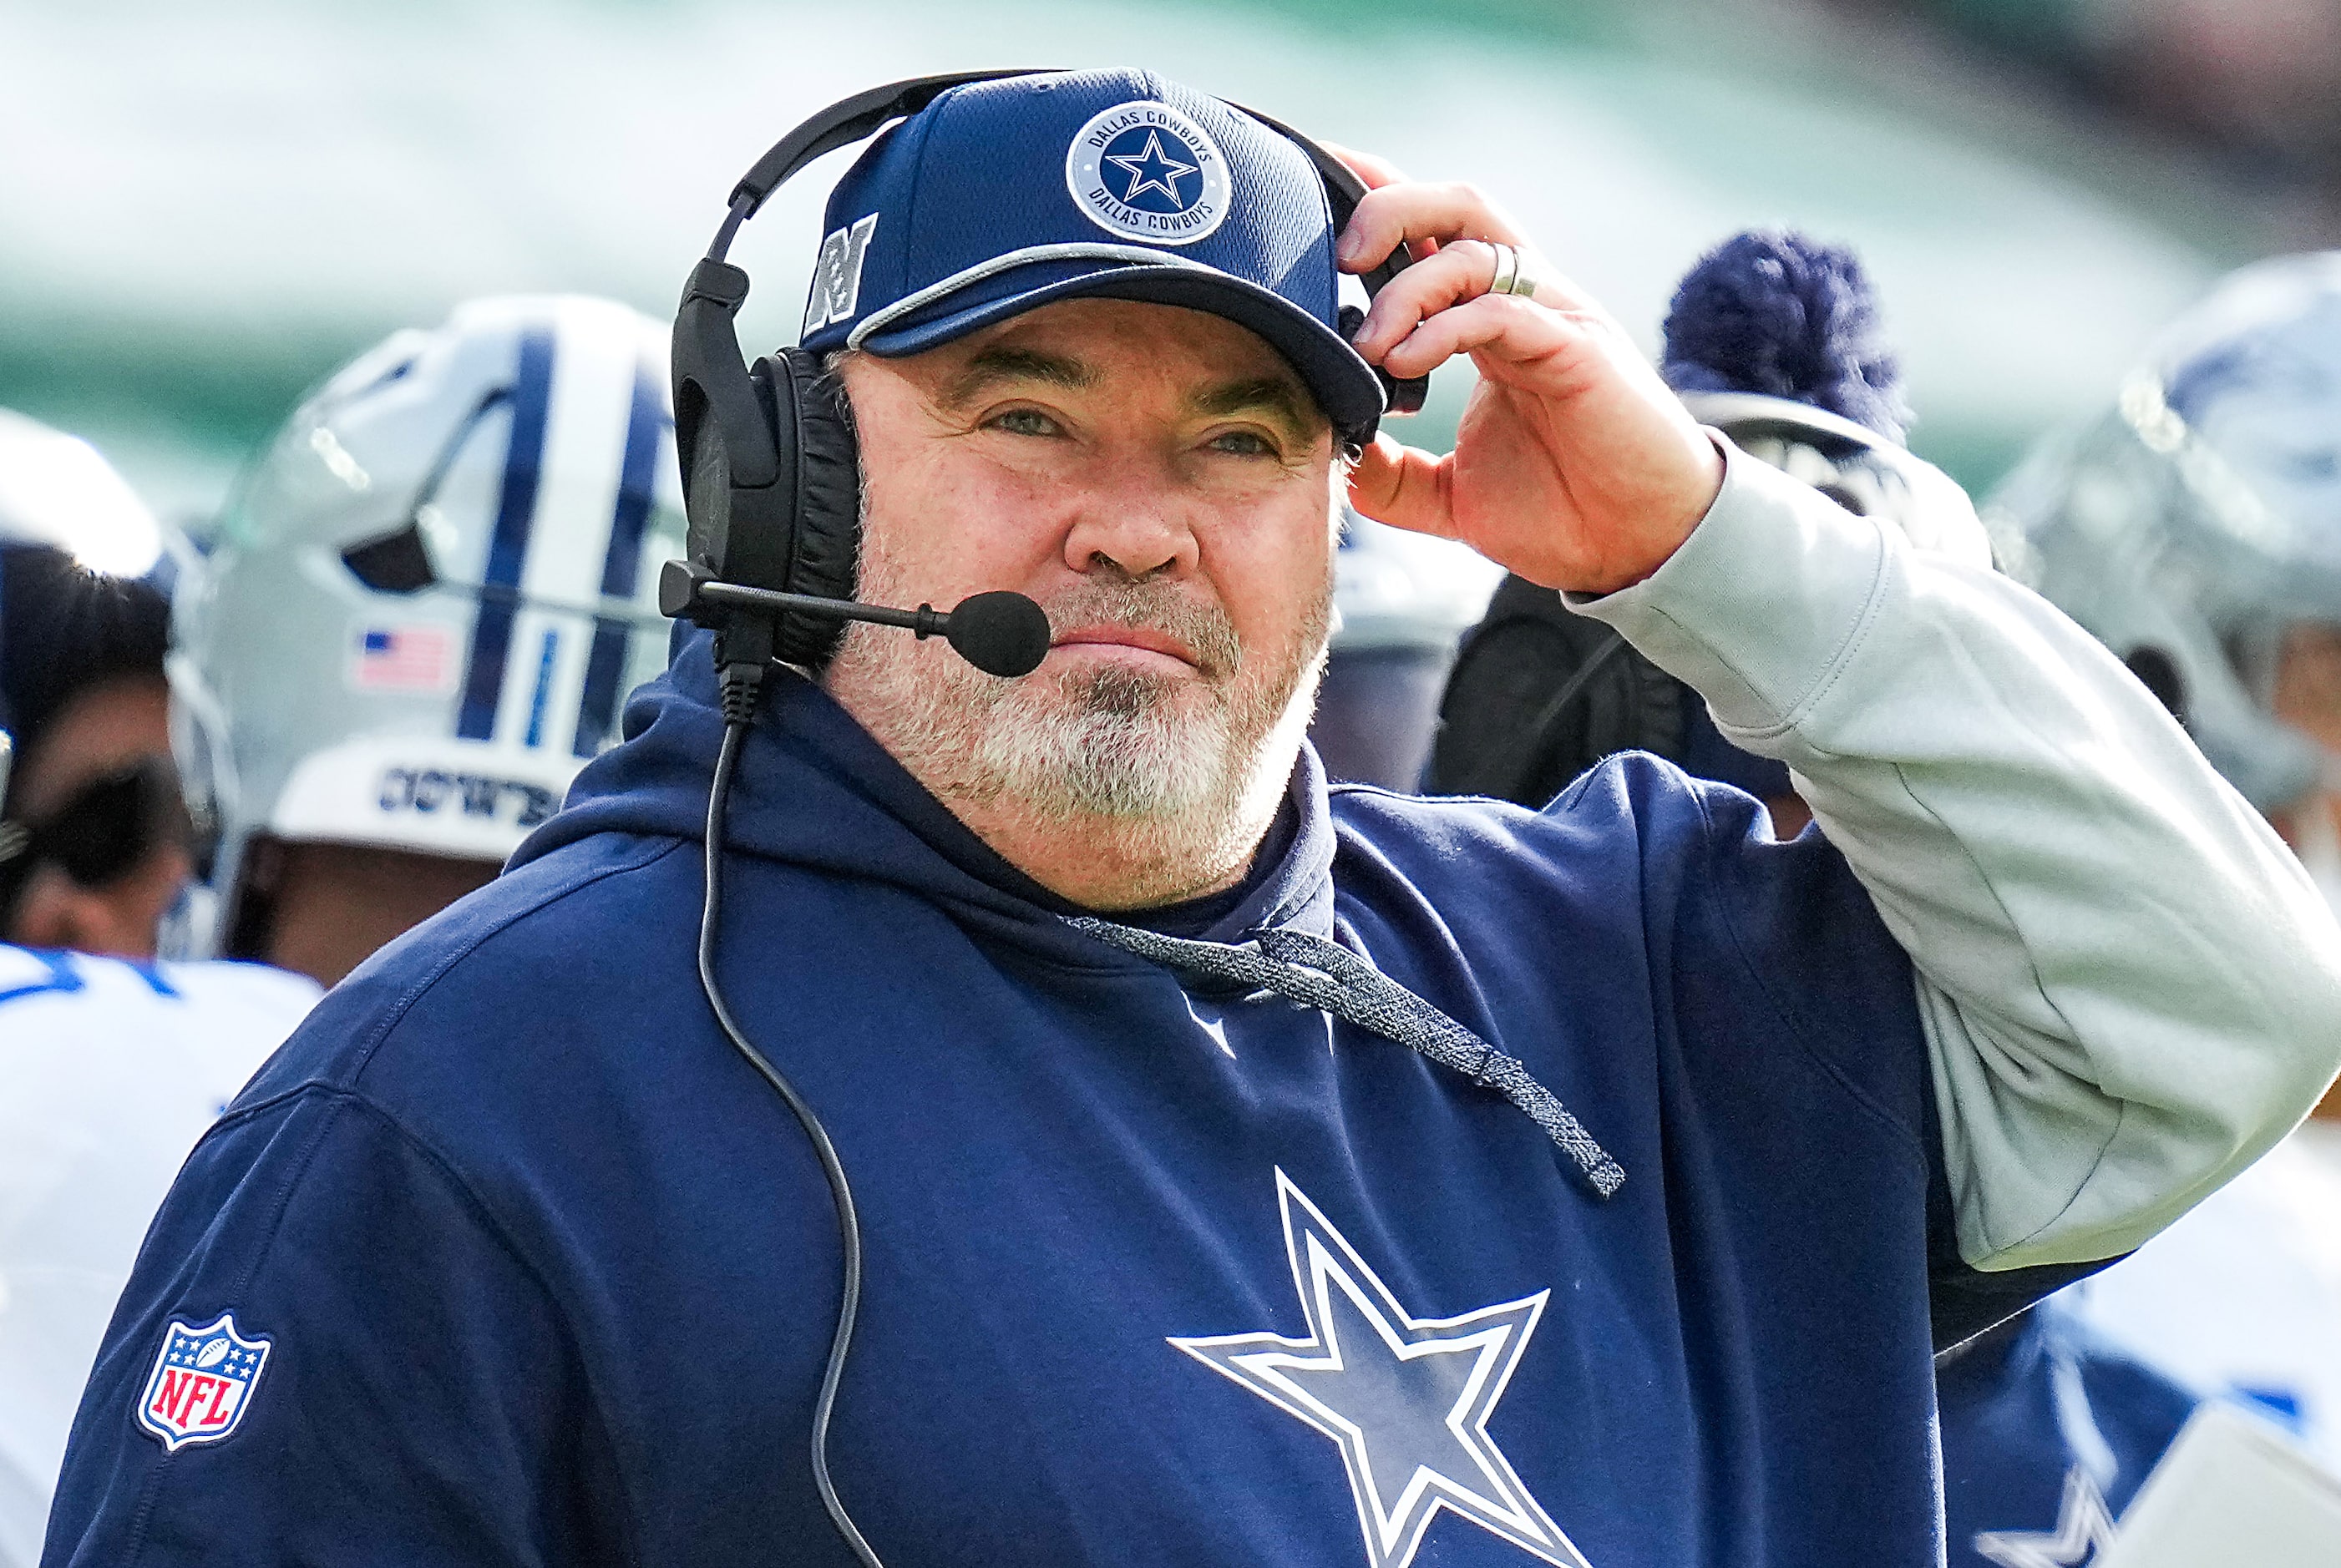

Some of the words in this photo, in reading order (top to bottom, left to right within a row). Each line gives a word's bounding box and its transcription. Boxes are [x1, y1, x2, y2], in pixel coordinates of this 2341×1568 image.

[1087, 111, 1141, 149] DALLAS
[1146, 110, 1213, 163] COWBOYS
[1088, 187, 1142, 226] DALLAS
[1148, 200, 1213, 231] COWBOYS
[803, 211, 879, 338] N
[151, 1369, 231, 1429] NFL
